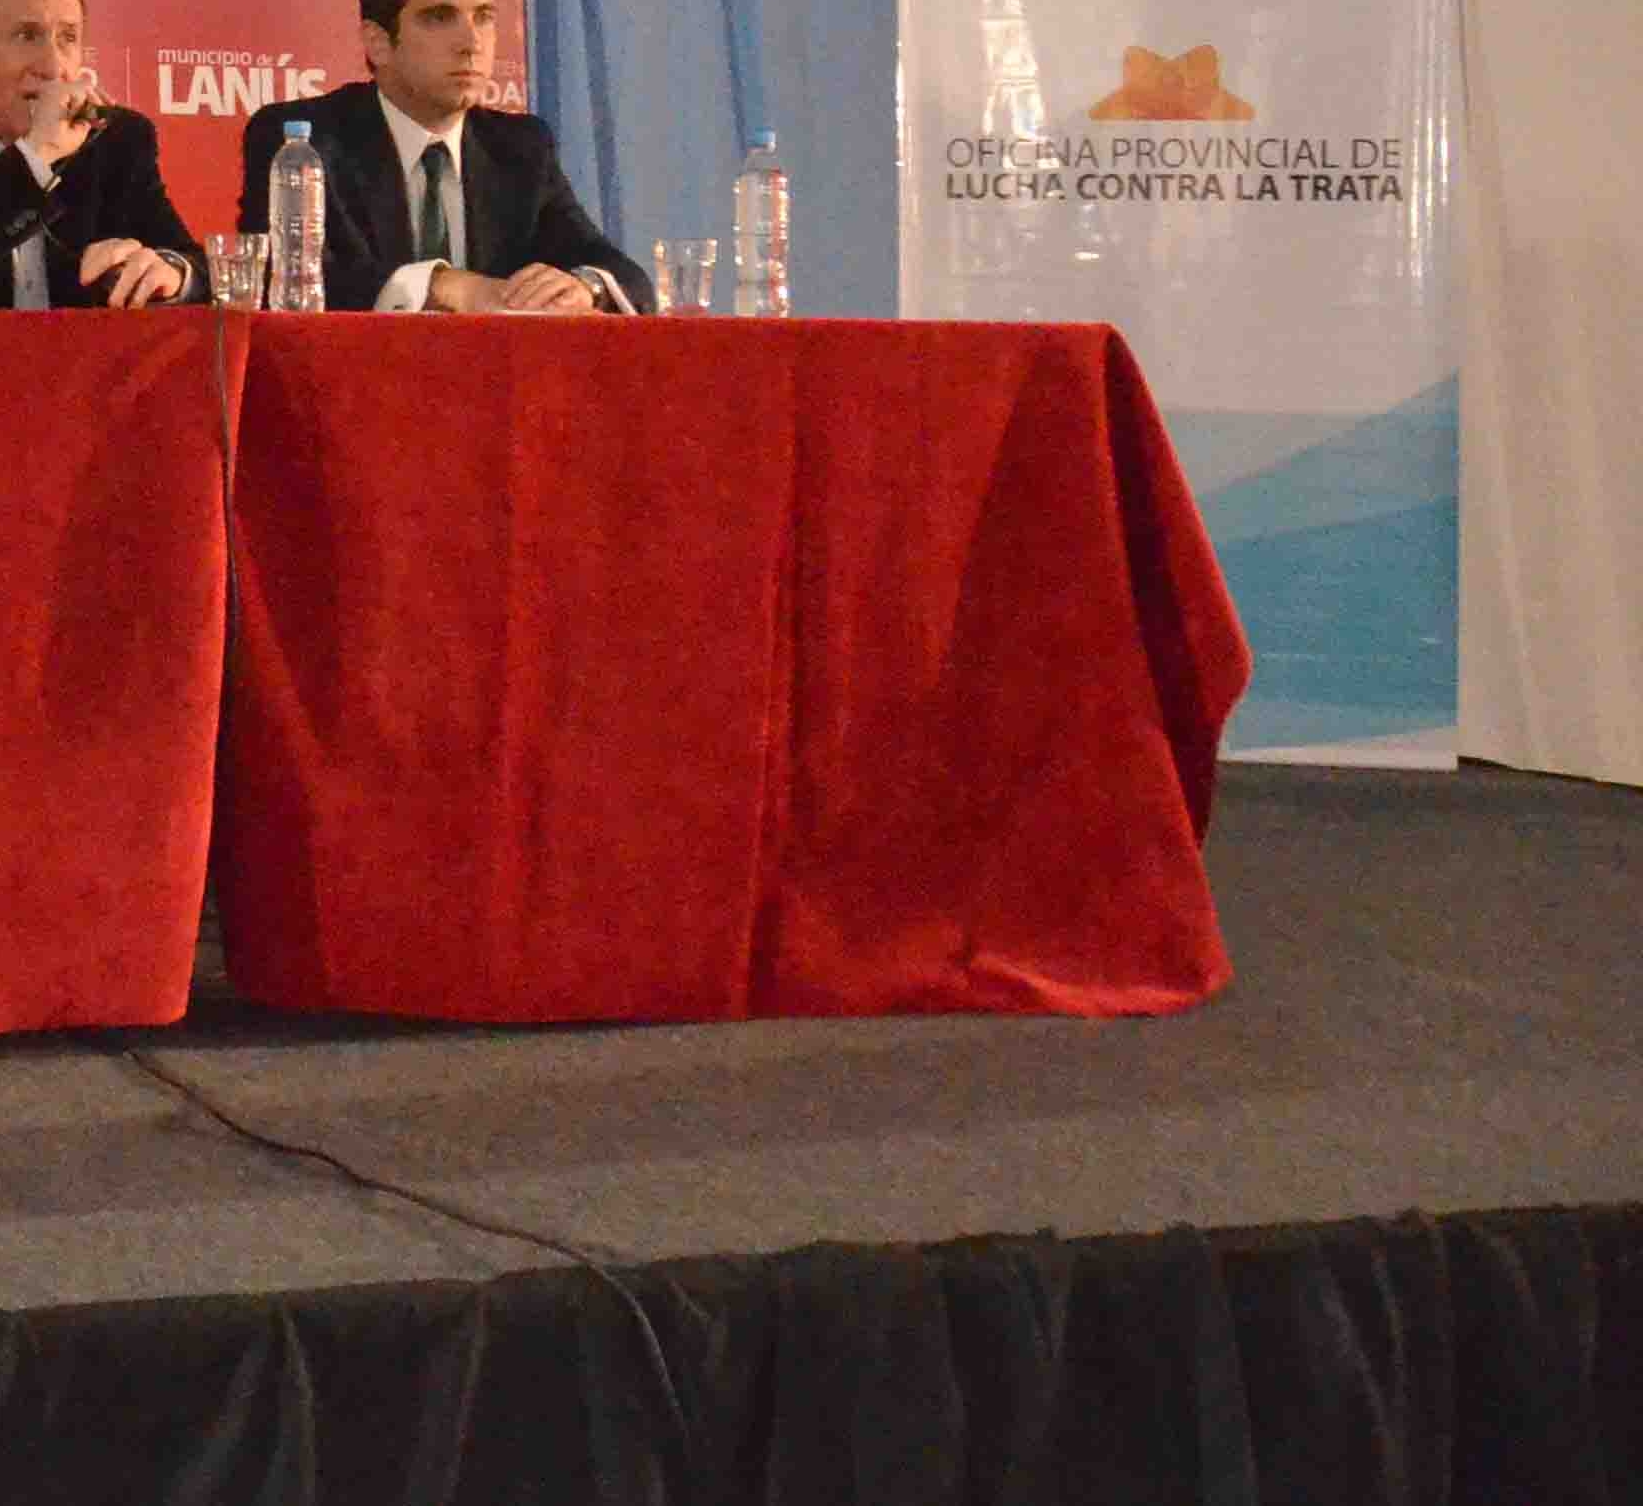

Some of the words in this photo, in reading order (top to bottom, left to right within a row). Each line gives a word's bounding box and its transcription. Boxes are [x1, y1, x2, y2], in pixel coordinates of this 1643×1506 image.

[947, 138, 1099, 169] OFICINA
[1113, 138, 1340, 169] PROVINCIAL
[1351, 139, 1402, 169] DE
[946, 174, 1066, 200] LUCHA
[1076, 174, 1225, 201] CONTRA
[1235, 174, 1280, 201] LA
[1288, 175, 1404, 202] TRATA
